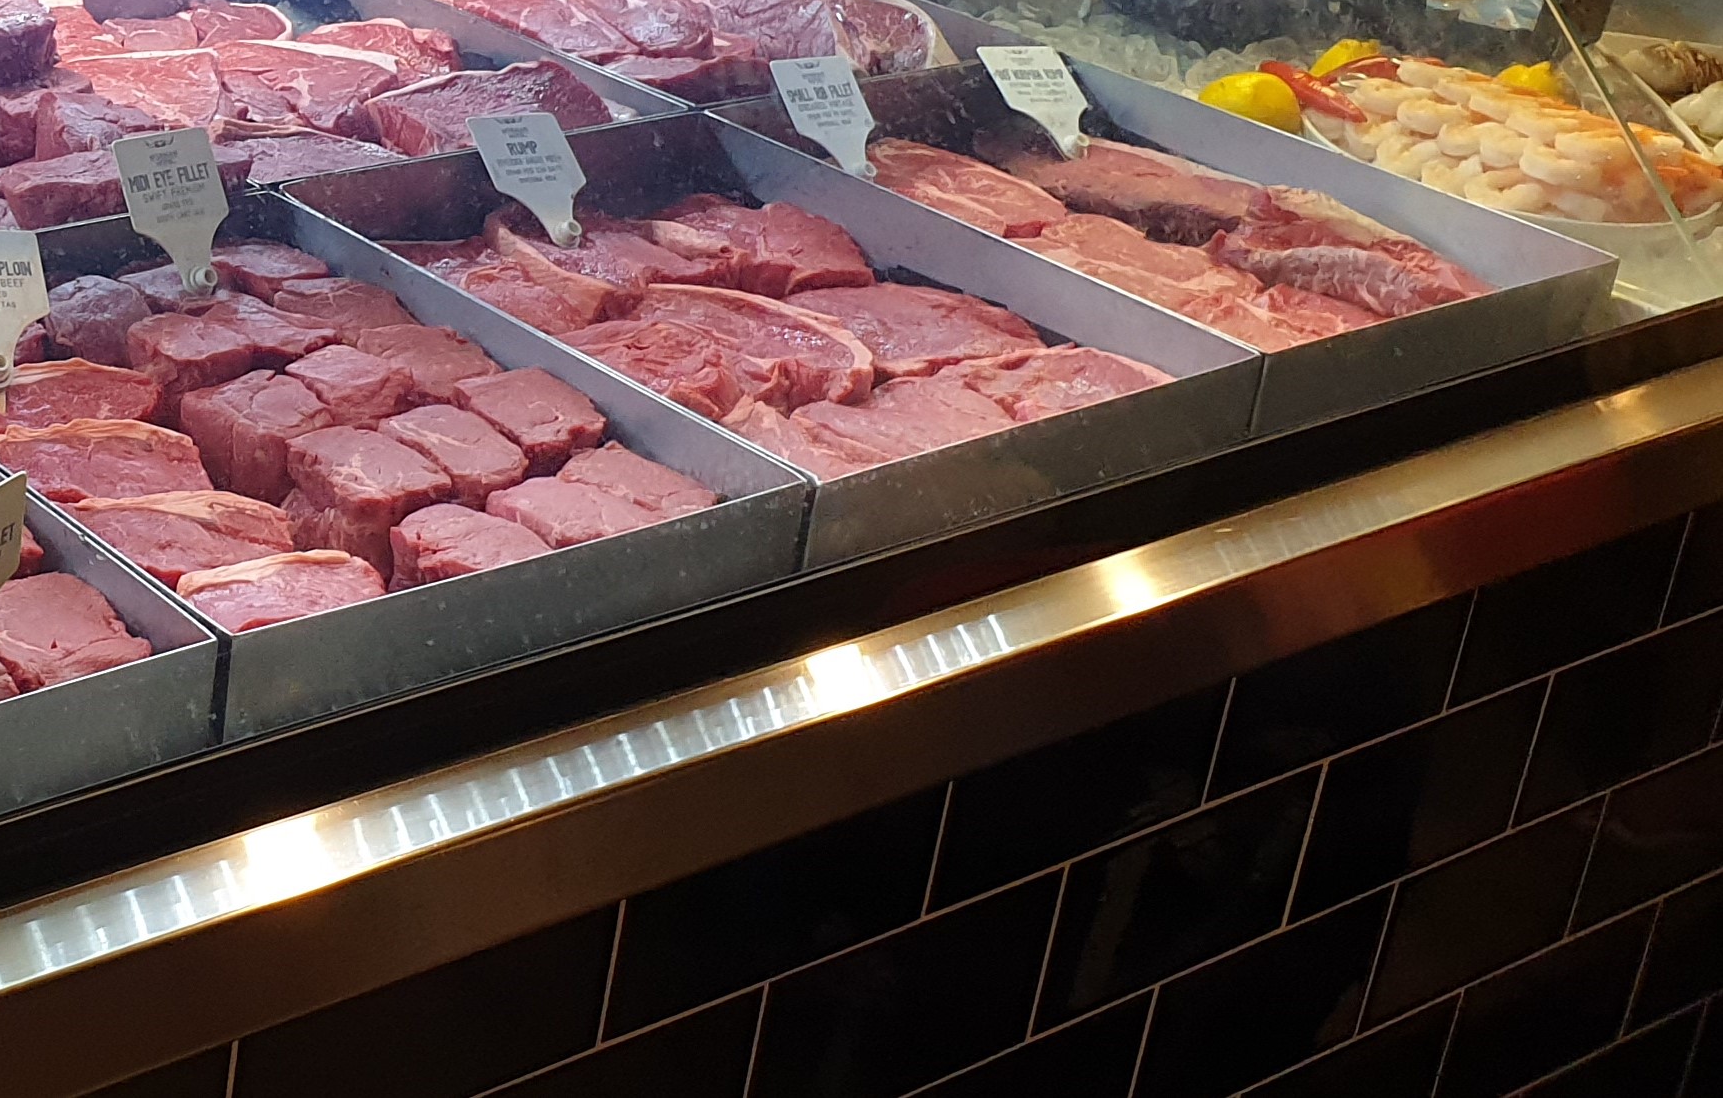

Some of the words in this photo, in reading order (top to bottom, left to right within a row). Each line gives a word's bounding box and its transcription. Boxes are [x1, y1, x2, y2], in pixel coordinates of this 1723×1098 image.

[505, 140, 538, 156] RUMP
[152, 168, 175, 189] EYE
[176, 162, 210, 184] FILLET
[0, 278, 23, 288] BEEF
